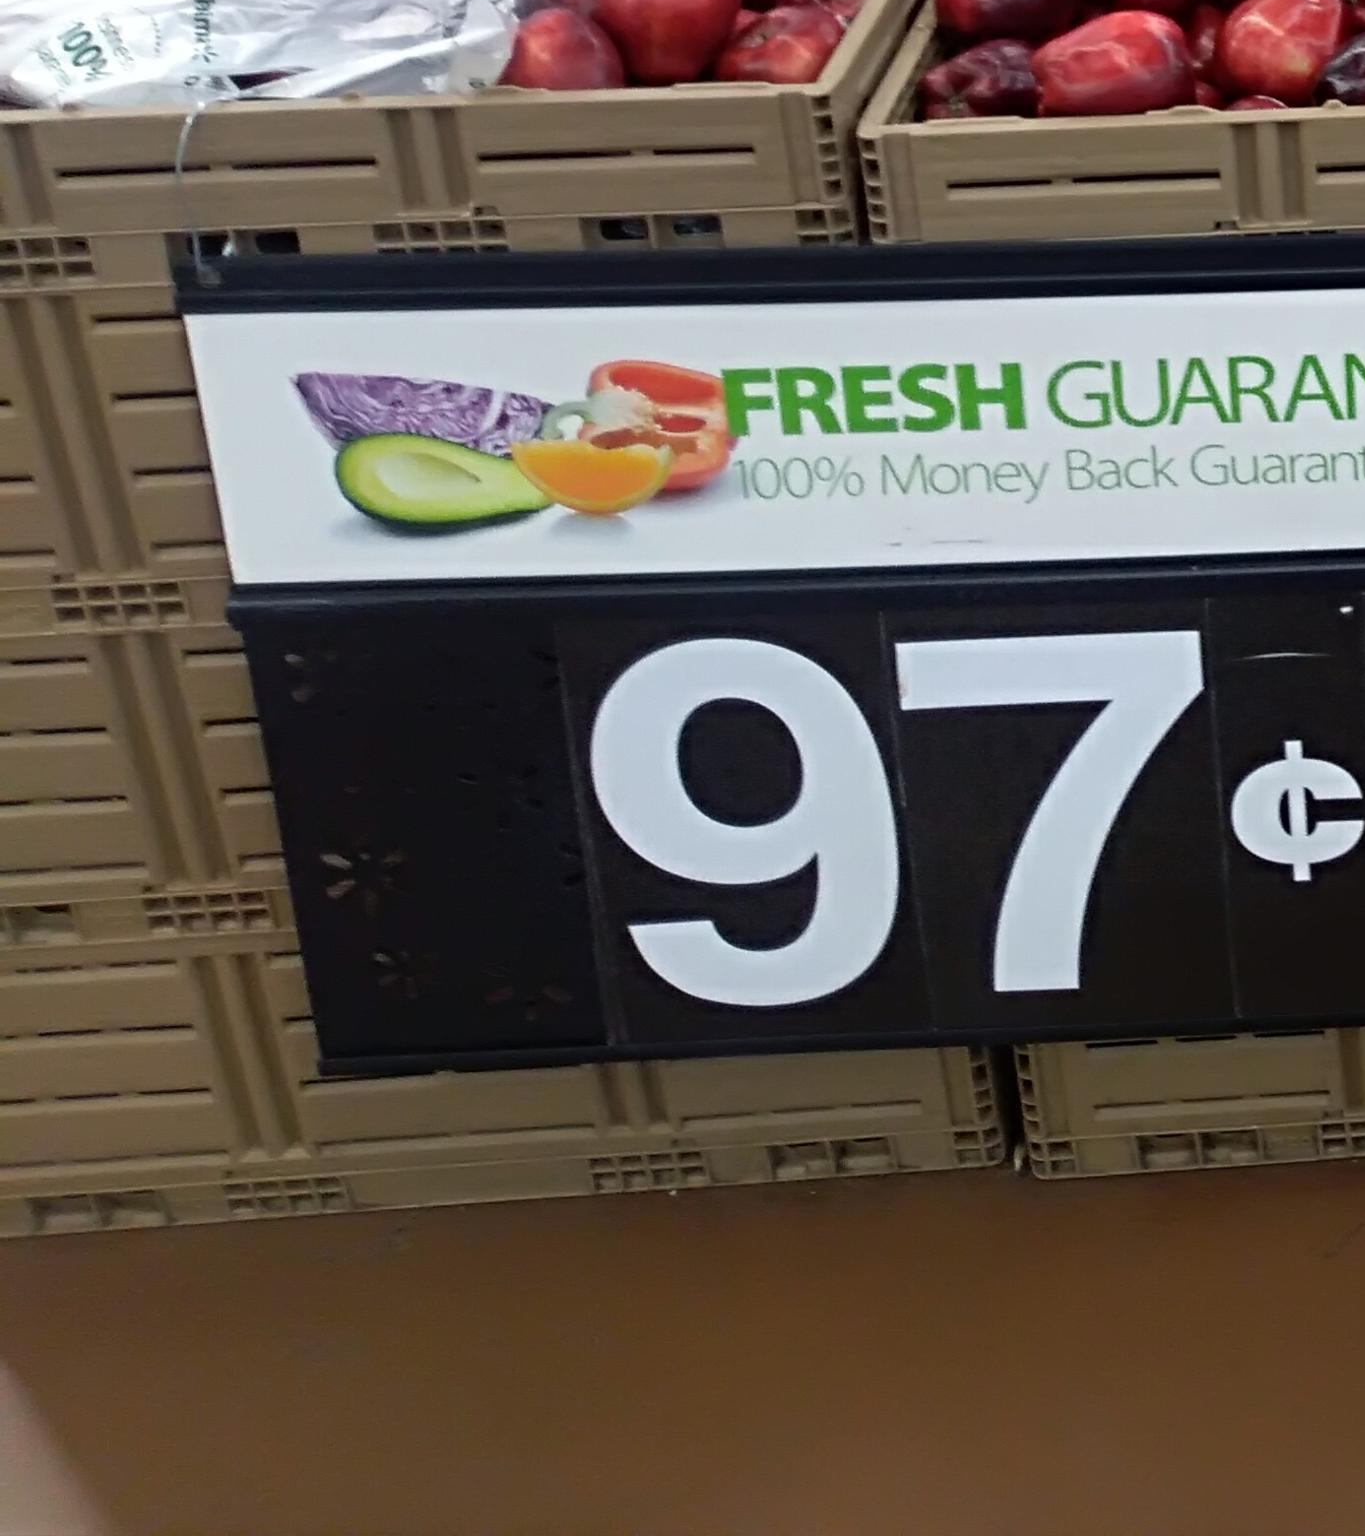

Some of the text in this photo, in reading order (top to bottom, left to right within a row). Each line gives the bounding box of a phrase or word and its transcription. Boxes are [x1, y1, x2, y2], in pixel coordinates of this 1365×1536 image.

[721, 361, 1027, 438] FRESH
[733, 453, 865, 503] 100%
[880, 452, 1050, 505] Money
[1064, 444, 1179, 492] Back
[589, 629, 1205, 1007] 97
